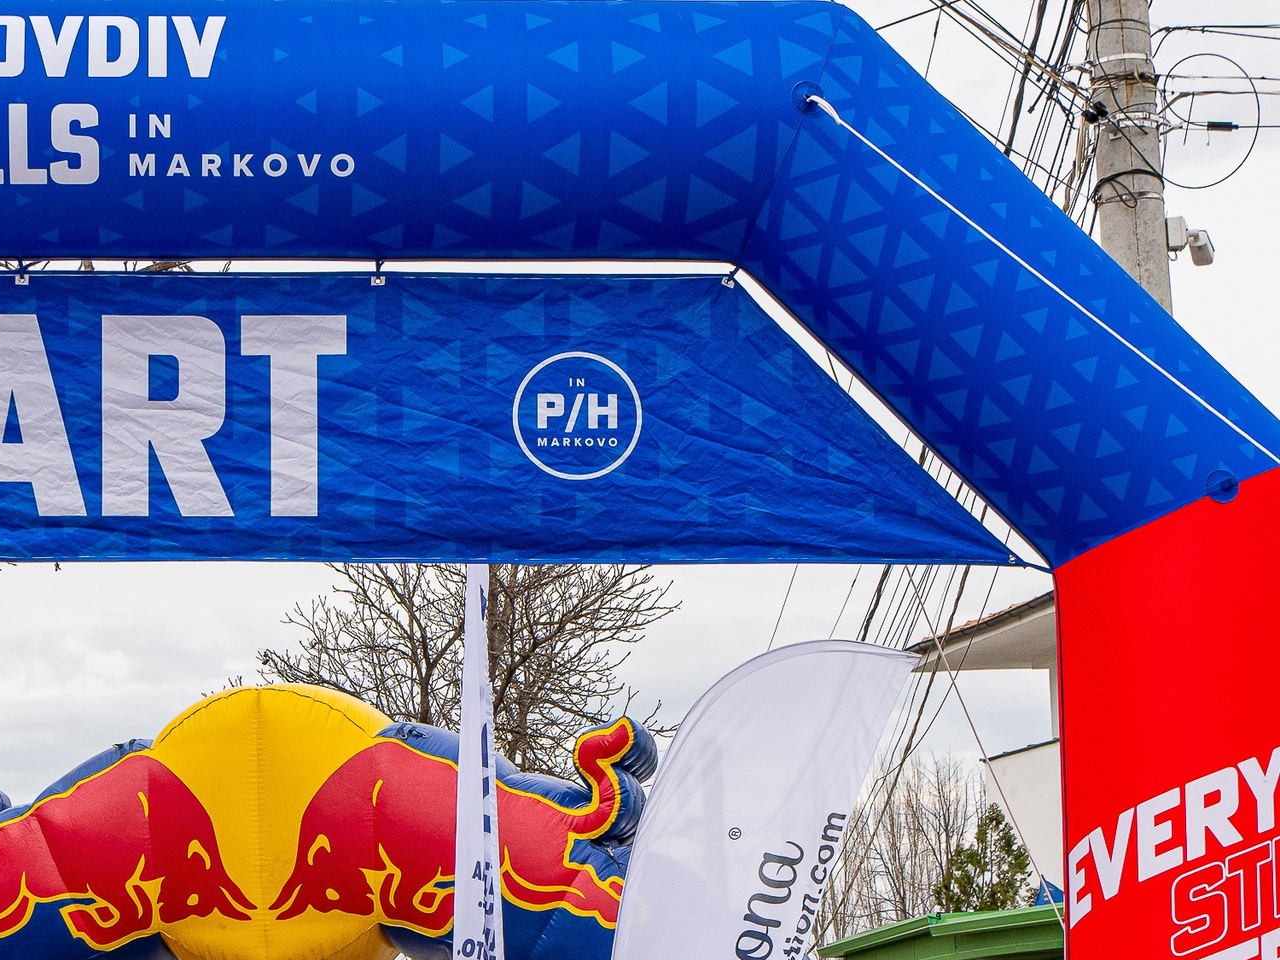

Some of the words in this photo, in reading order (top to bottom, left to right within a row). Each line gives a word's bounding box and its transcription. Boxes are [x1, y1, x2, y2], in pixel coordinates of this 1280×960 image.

[129, 113, 172, 139] IN
[129, 152, 356, 178] MARKOVO
[568, 377, 586, 387] IN
[536, 392, 618, 433] P/H
[536, 437, 618, 447] MARKOVO
[1069, 746, 1280, 931] EVERY
